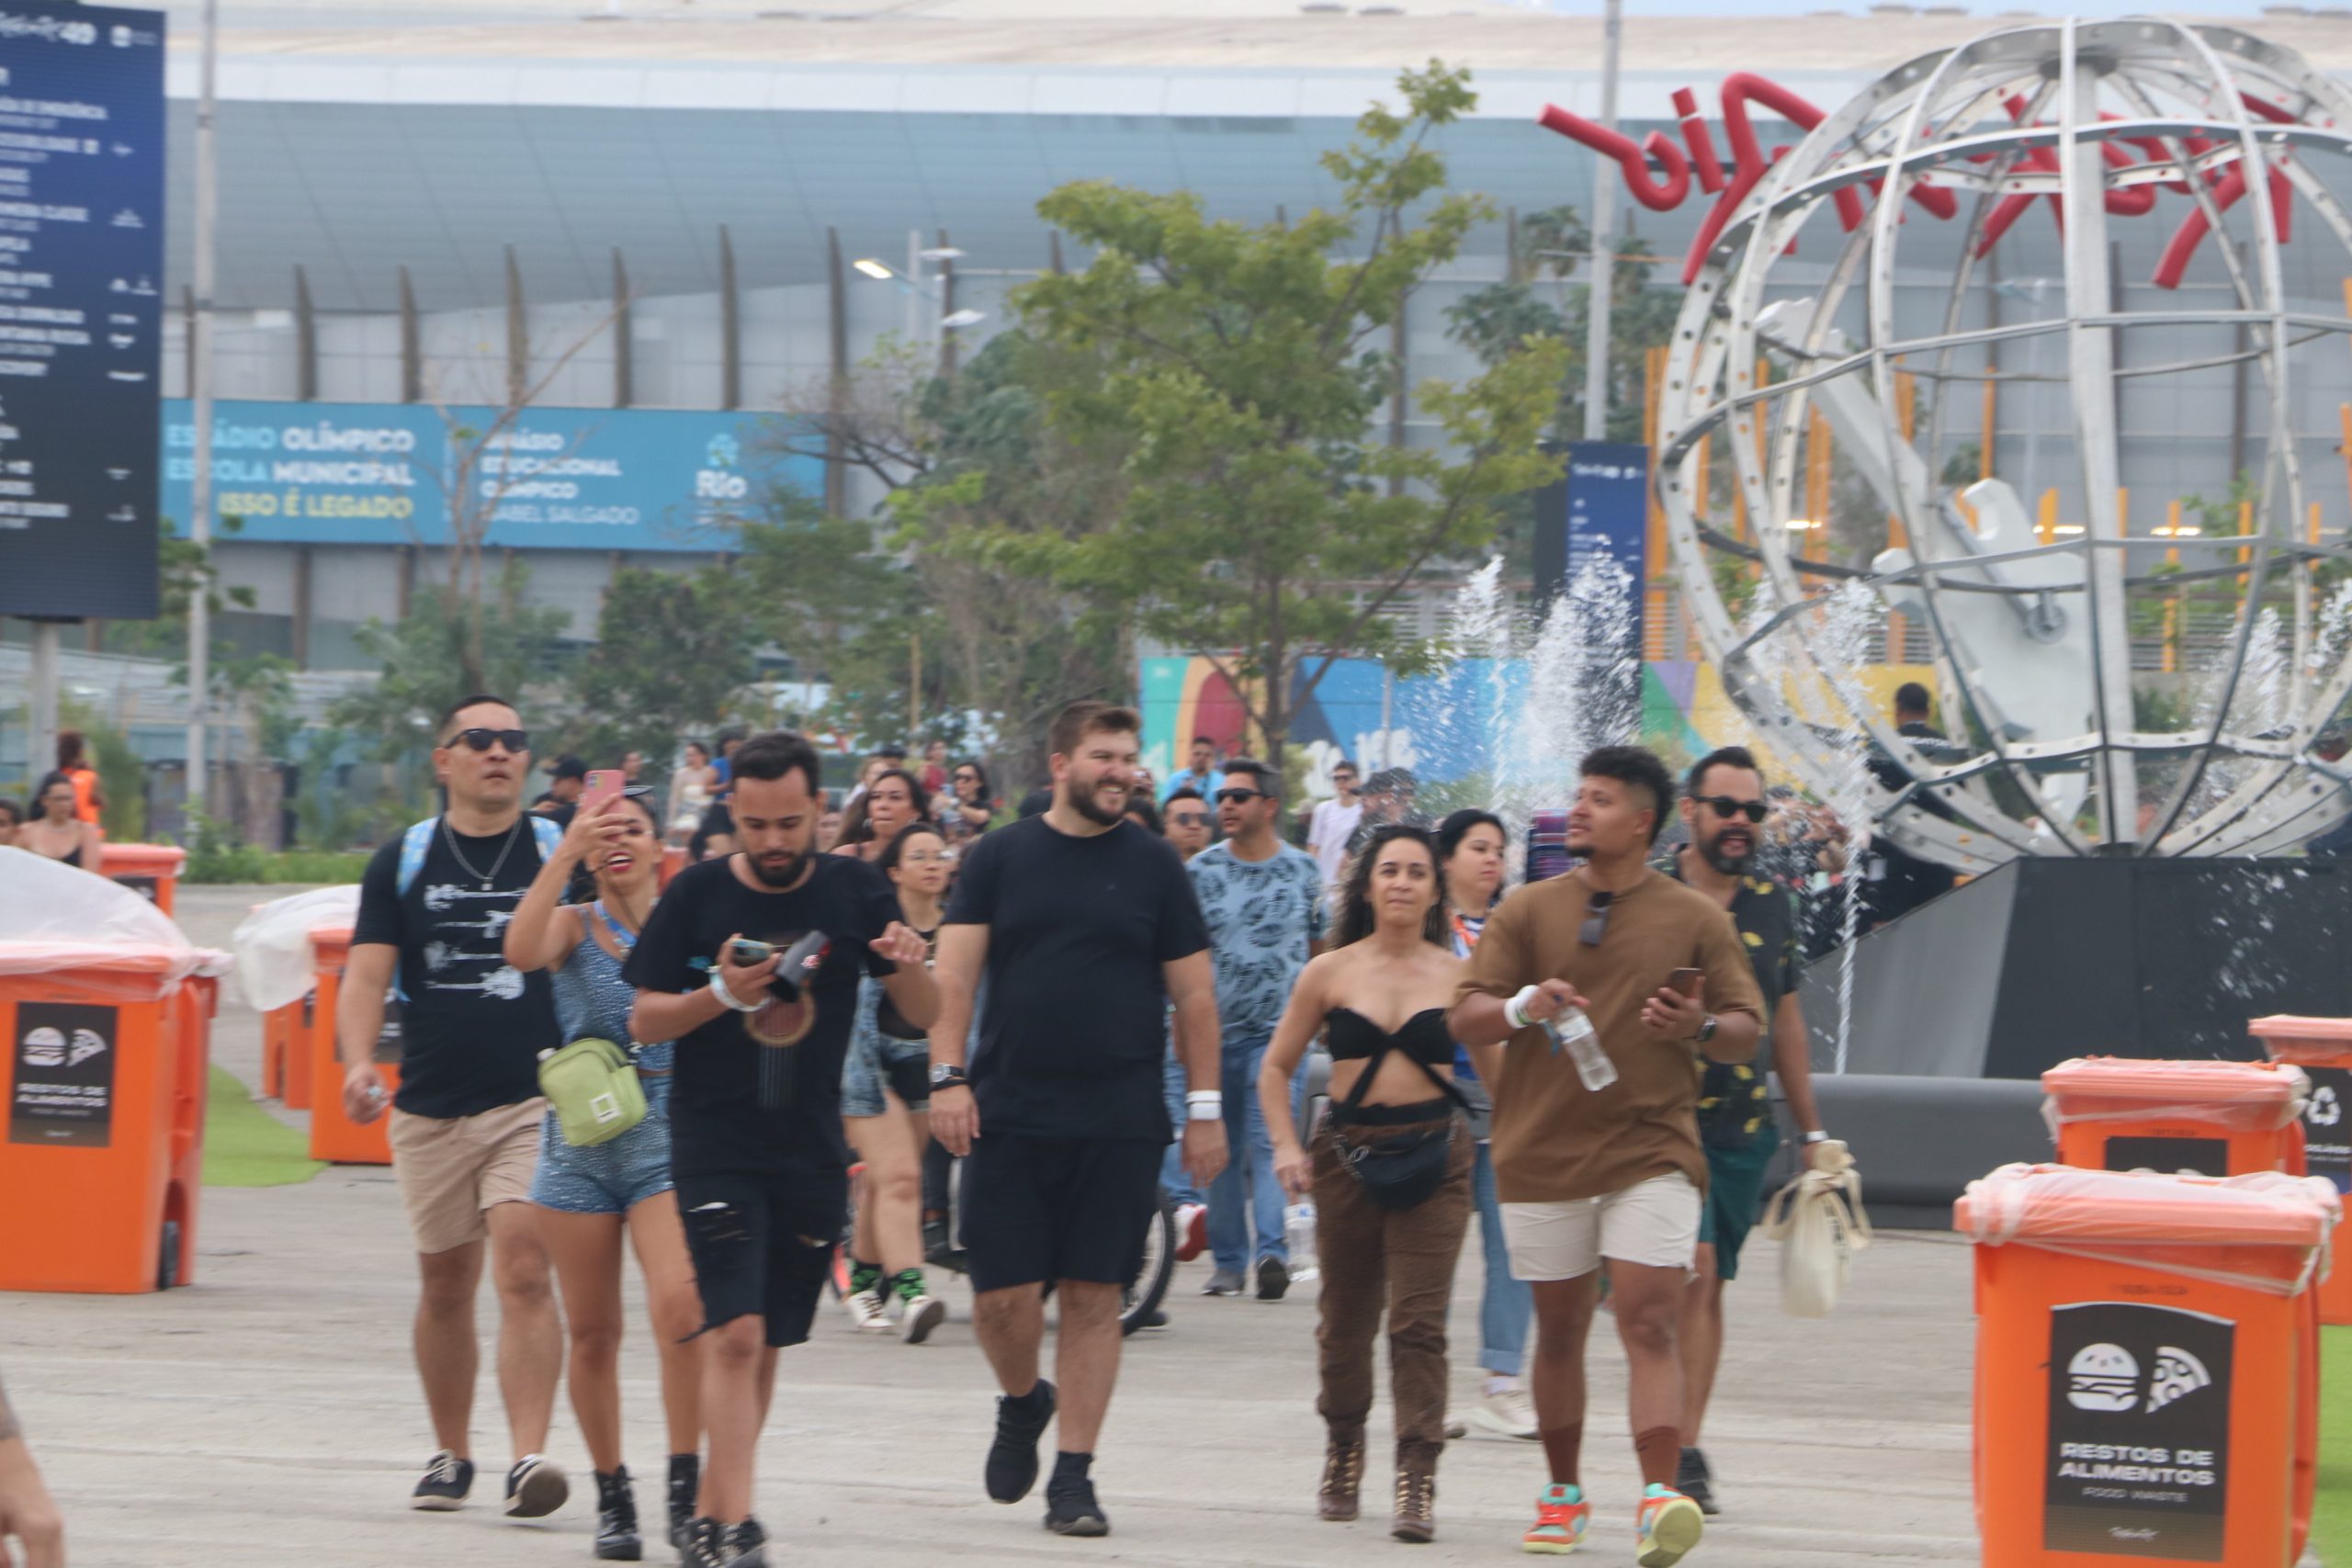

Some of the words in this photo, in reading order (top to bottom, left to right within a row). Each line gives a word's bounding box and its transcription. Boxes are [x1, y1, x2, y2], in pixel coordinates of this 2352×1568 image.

[165, 417, 277, 450] ESÁDIO
[281, 420, 415, 452] OLÍMPICO
[165, 457, 269, 481] ESOLA
[273, 460, 416, 485] MUNICIPAL
[218, 491, 278, 516] ISSO
[283, 487, 300, 516] É
[306, 495, 413, 520] LEGADO
[2060, 1441, 2170, 1463] RESTOS
[2176, 1449, 2214, 1466] DE
[2058, 1461, 2216, 1485] ALIMENTOS
[2082, 1486, 2128, 1499] FOOD
[2130, 1489, 2189, 1503] WASTE
